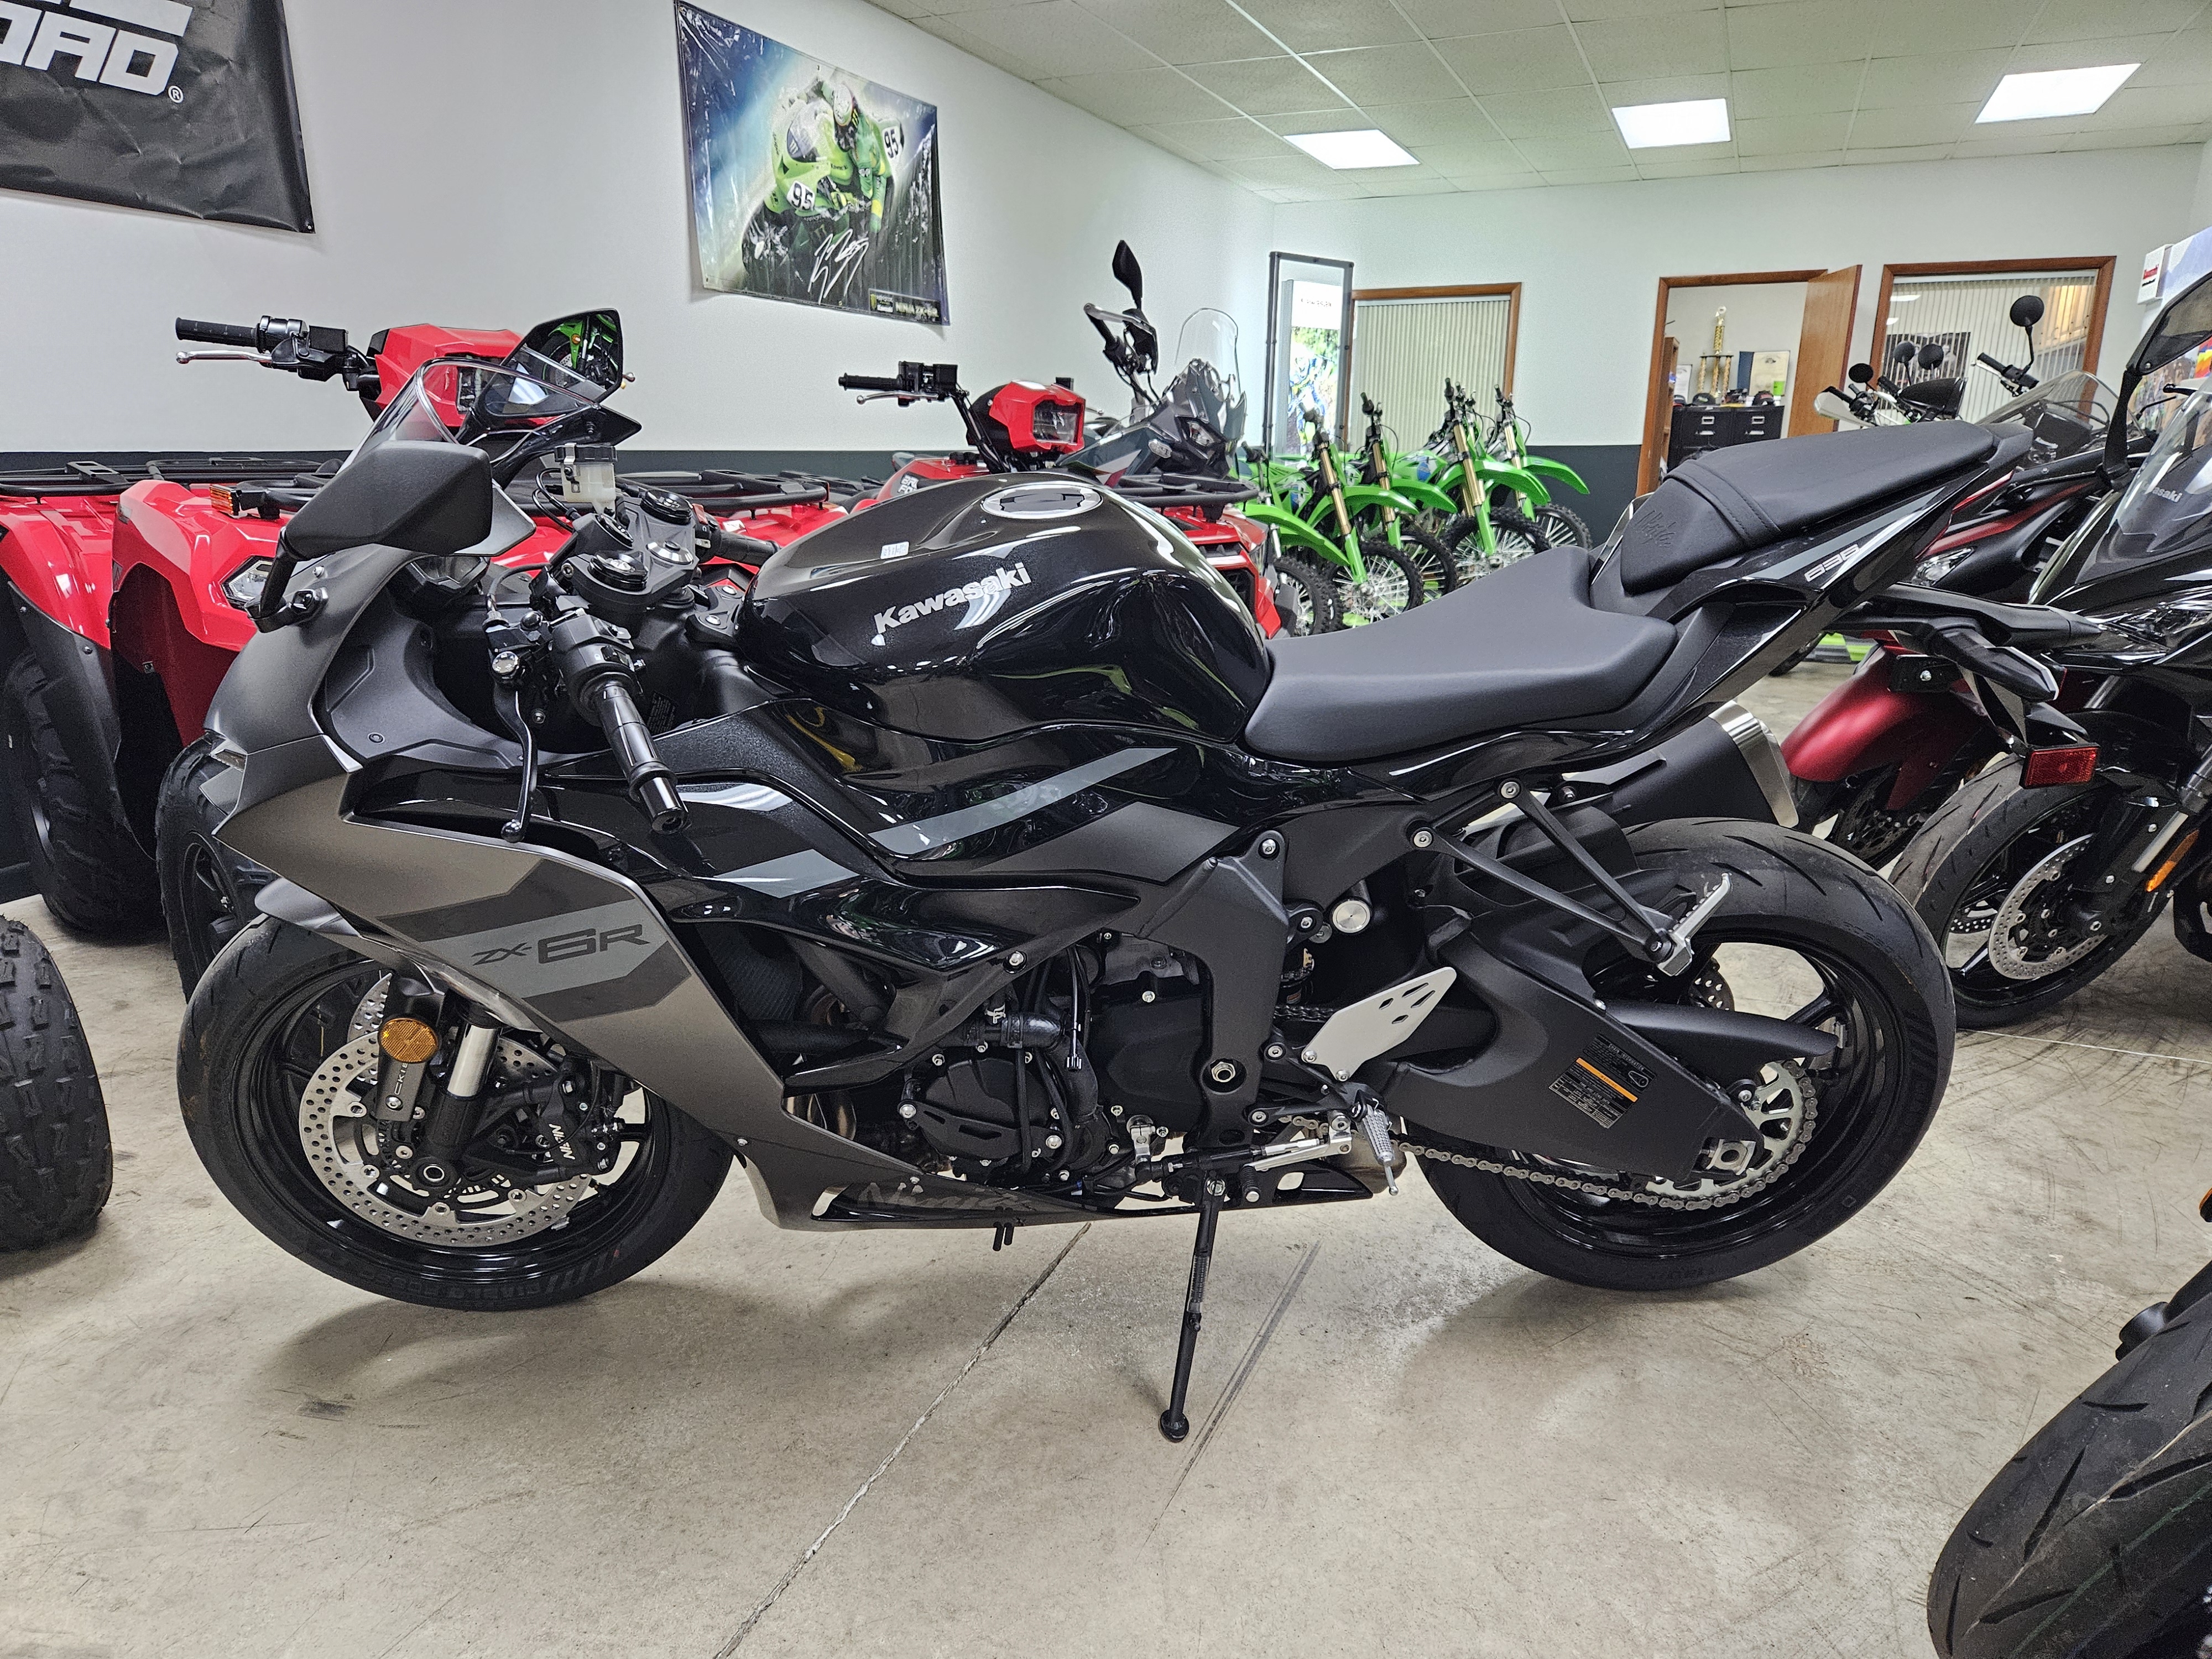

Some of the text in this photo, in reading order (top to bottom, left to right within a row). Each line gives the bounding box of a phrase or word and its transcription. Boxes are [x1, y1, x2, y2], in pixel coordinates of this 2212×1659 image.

[885, 129, 899, 159] 95
[791, 182, 813, 211] 95
[1804, 544, 1860, 582] 636
[873, 562, 1032, 634] Kawasaki
[471, 924, 650, 966] ZX-6R
